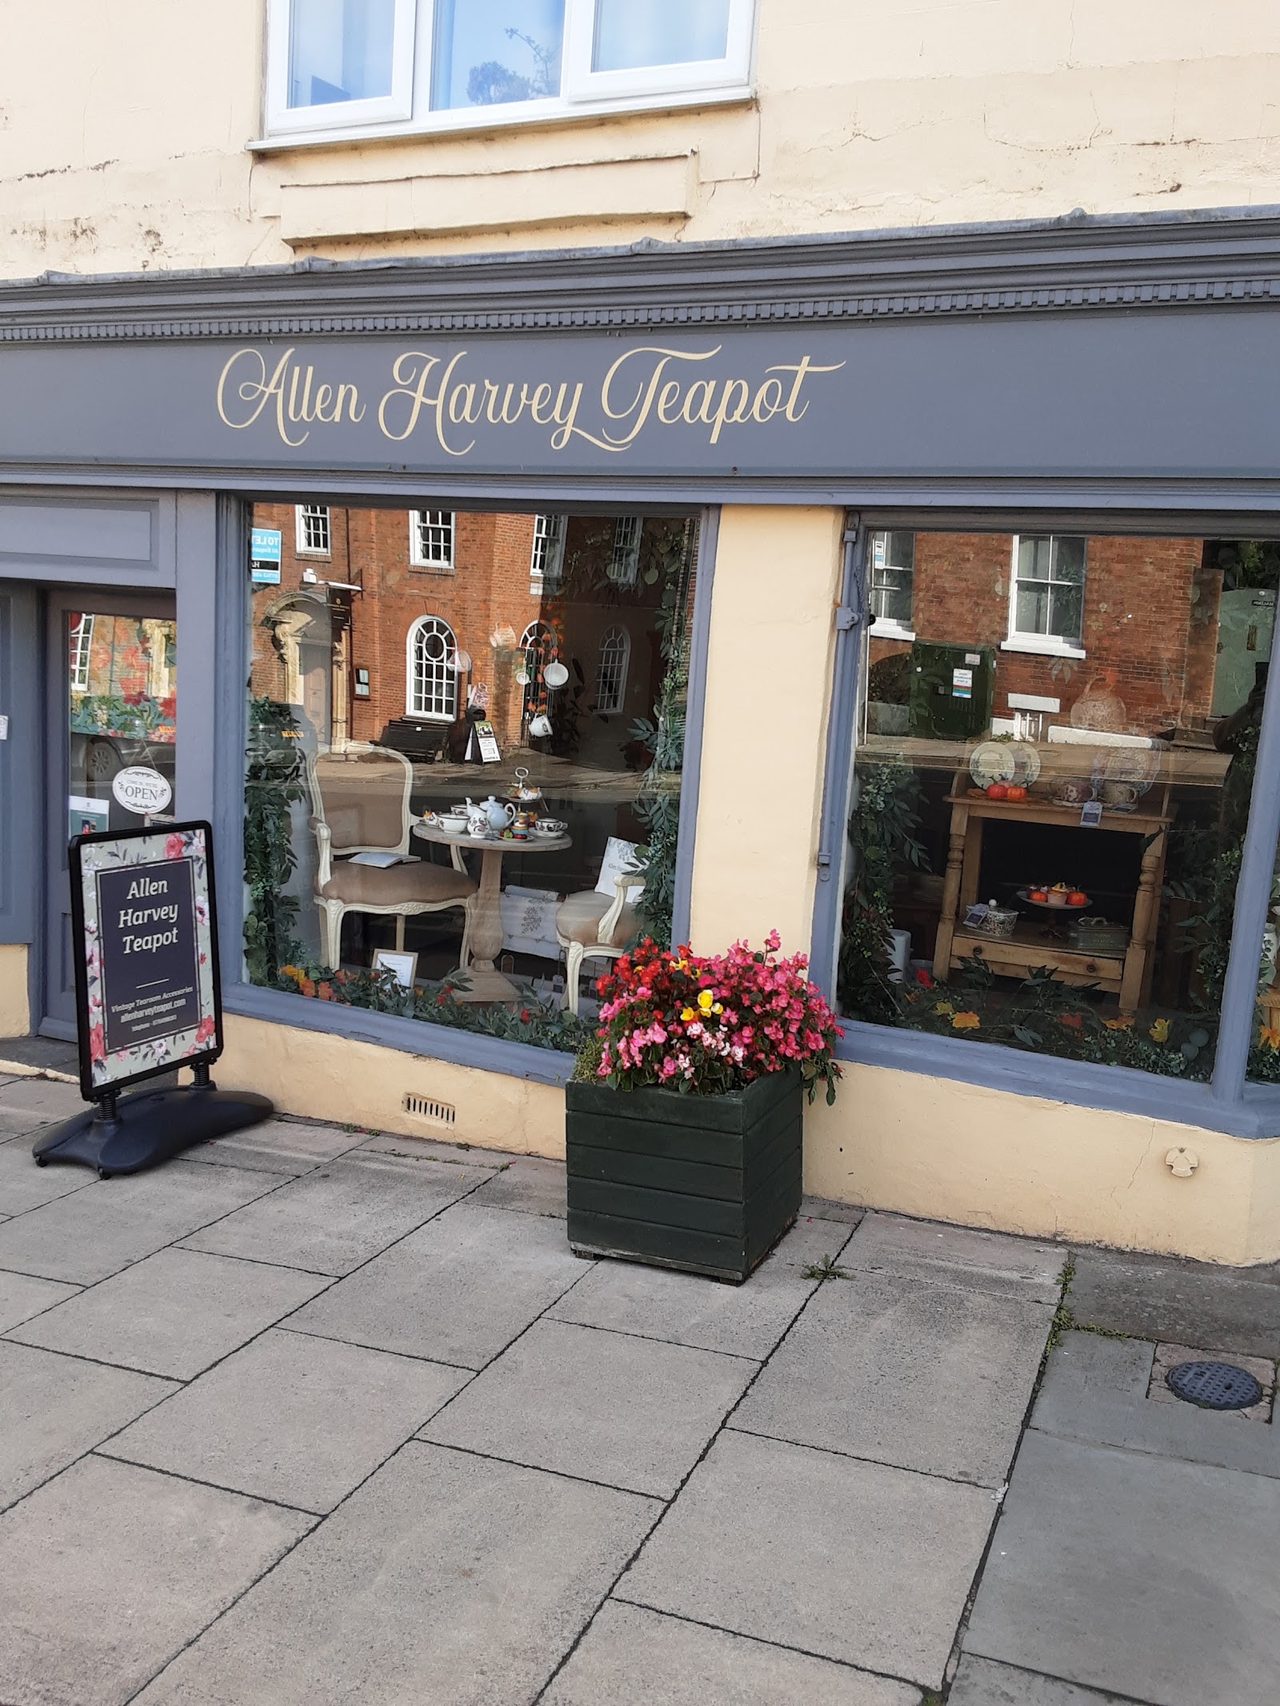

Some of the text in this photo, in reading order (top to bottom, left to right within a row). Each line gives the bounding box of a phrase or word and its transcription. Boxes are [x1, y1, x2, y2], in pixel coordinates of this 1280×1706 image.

[217, 344, 846, 455] Allen Harvey Teapot
[125, 785, 158, 801] OPEN
[126, 877, 169, 900] Allen
[118, 904, 179, 928] Harvey
[122, 927, 179, 954] Teapot
